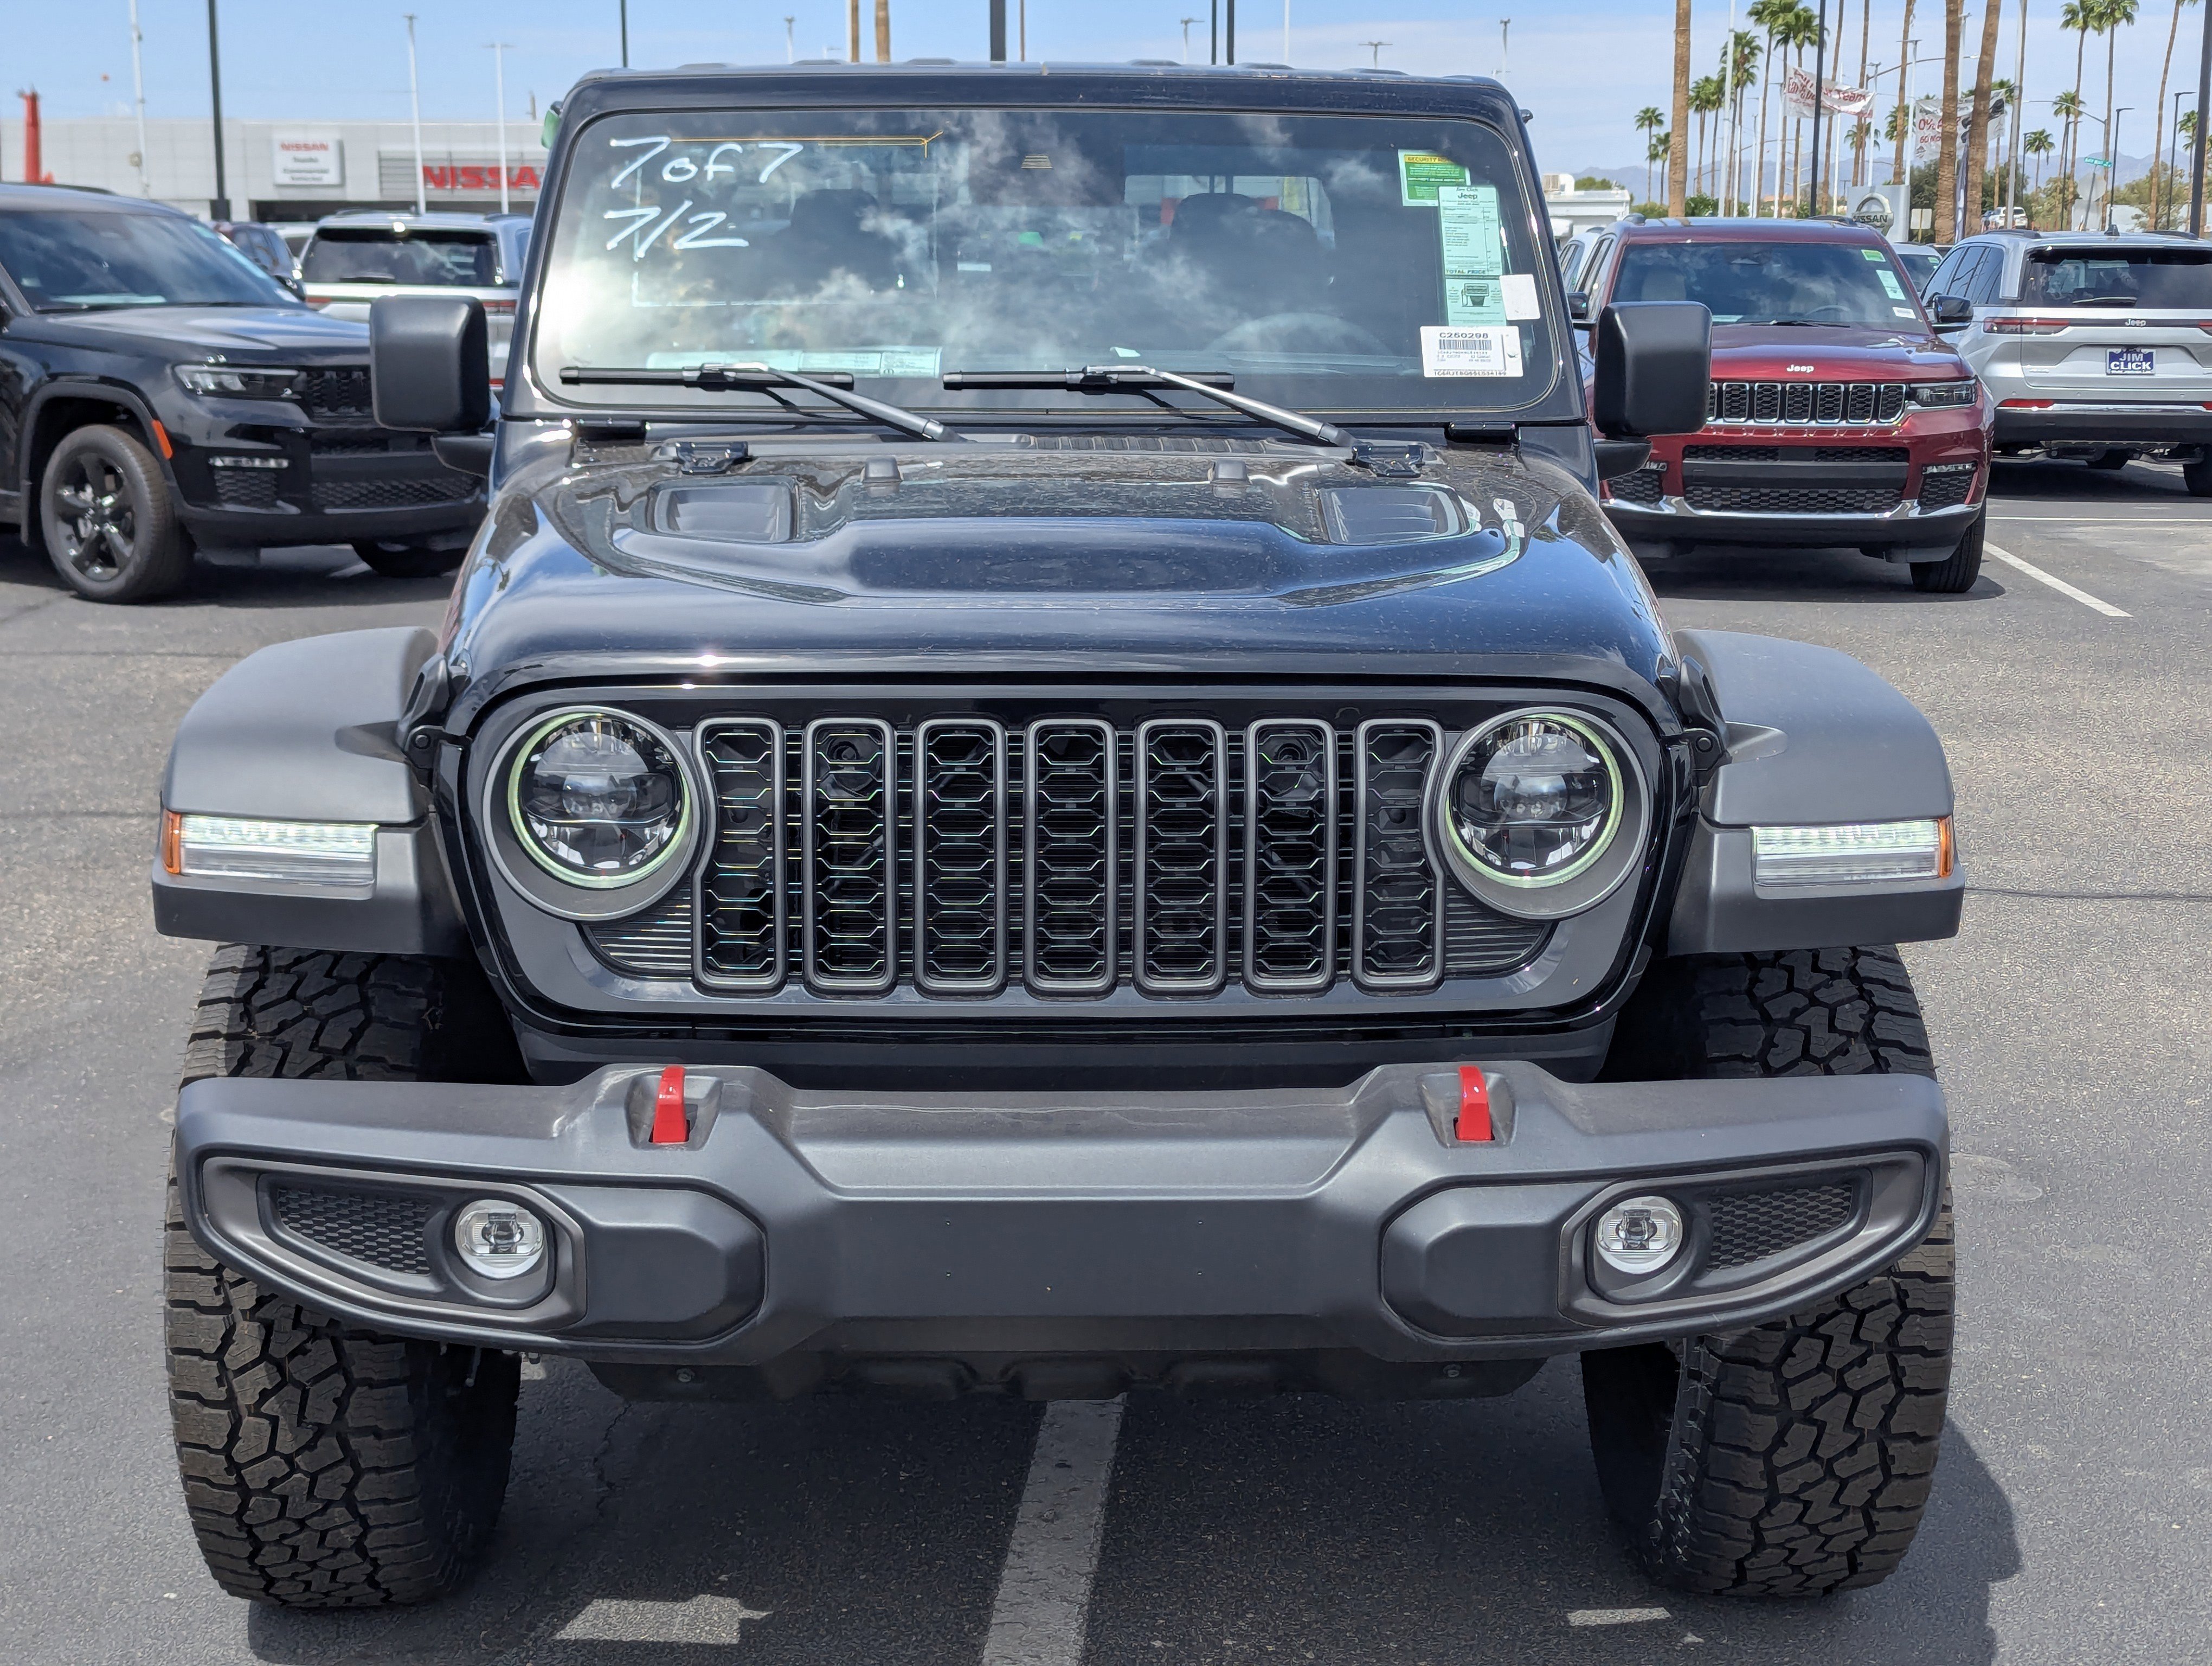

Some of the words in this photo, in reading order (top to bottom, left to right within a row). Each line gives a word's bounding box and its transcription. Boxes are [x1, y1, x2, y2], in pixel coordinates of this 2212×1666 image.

[609, 136, 672, 189] 7
[661, 143, 743, 182] of
[758, 143, 803, 183] 7
[423, 165, 544, 189] NISSA
[604, 199, 749, 258] 7/2
[2125, 318, 2146, 327] Jeep
[2119, 353, 2144, 362] JIM
[1786, 364, 1815, 373] Jeep
[2110, 361, 2151, 370] CLICK
